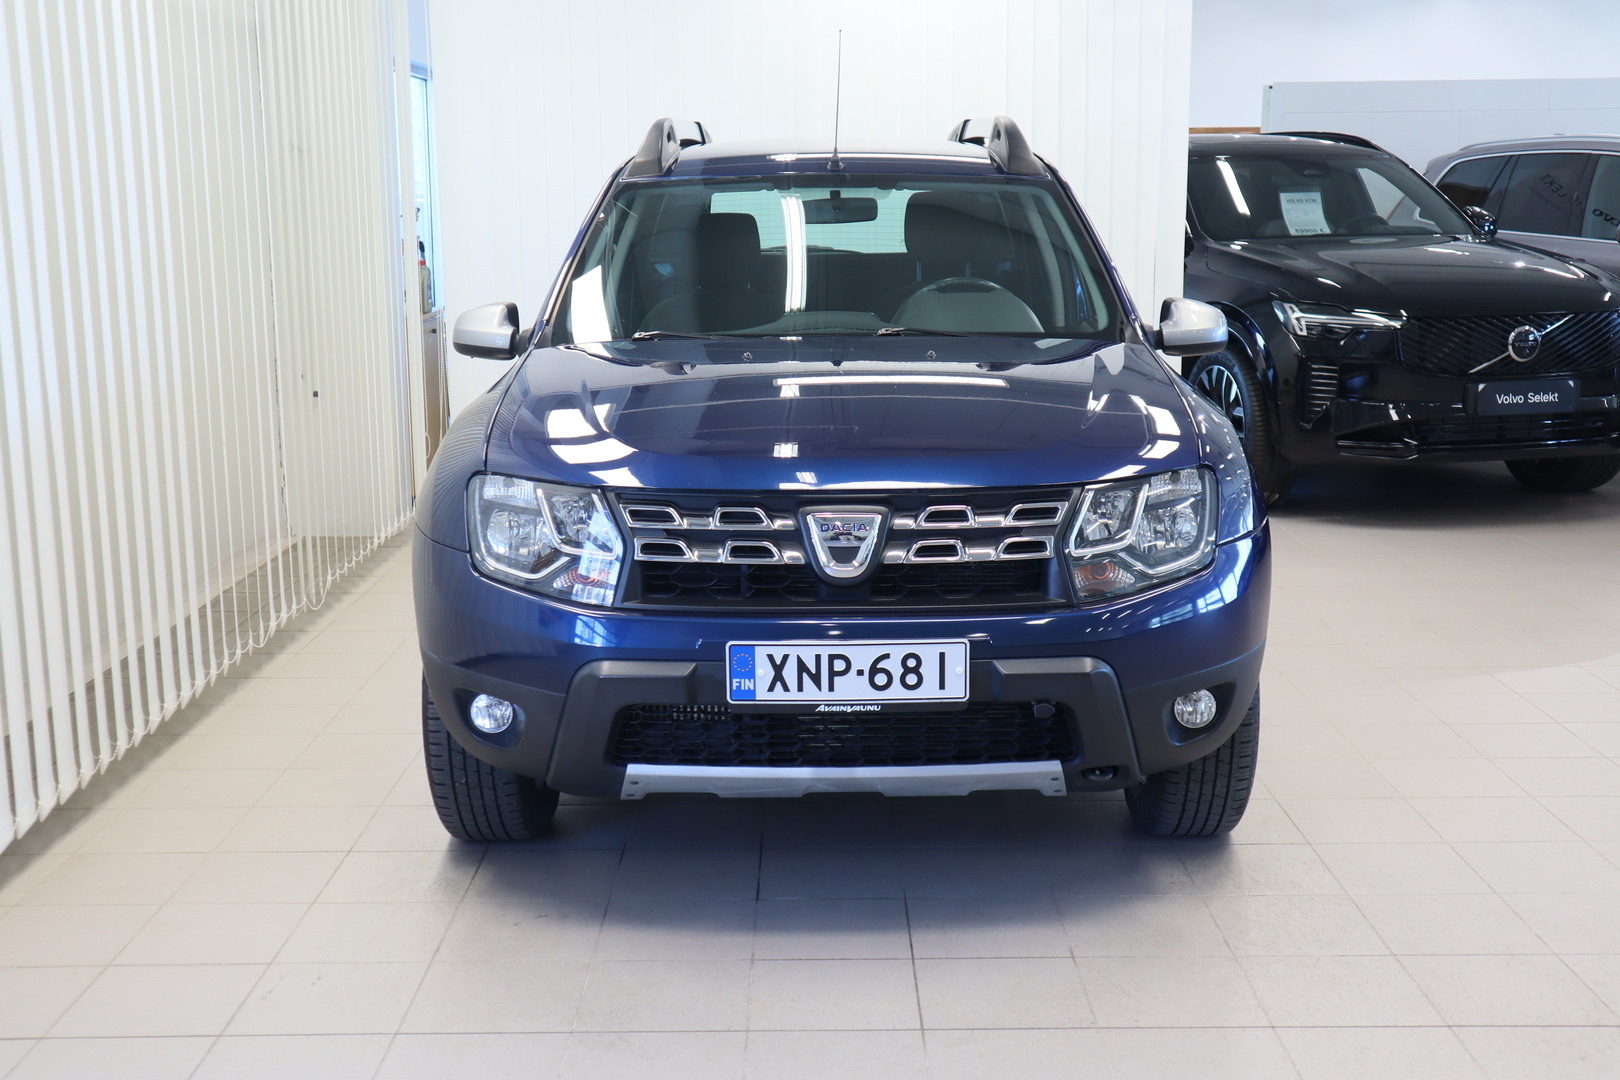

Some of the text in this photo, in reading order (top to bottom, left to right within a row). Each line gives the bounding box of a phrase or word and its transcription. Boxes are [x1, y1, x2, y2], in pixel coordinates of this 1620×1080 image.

[1496, 391, 1559, 404] Volvo Selekt
[820, 523, 868, 532] DACIA
[766, 651, 946, 692] XNP-681
[732, 679, 754, 690] FIN
